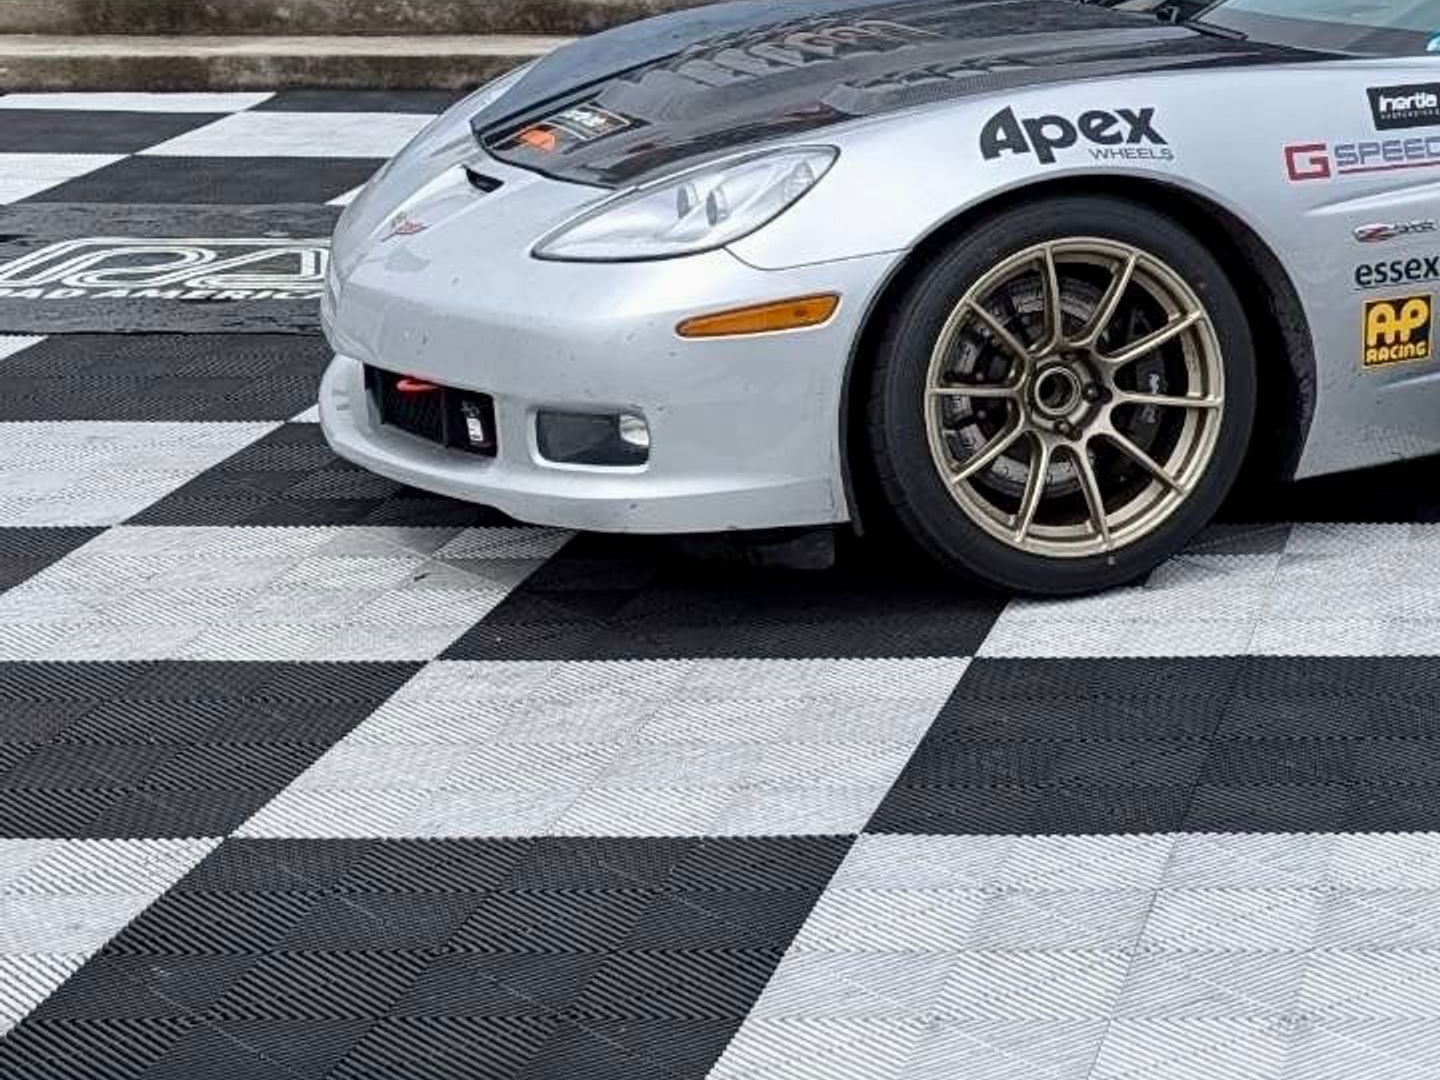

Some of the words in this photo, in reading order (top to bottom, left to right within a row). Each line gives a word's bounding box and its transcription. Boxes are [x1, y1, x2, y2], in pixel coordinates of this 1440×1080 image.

[980, 104, 1170, 164] Apex
[1090, 147, 1174, 161] WHEELS
[1285, 142, 1331, 181] G
[1355, 254, 1440, 286] essex
